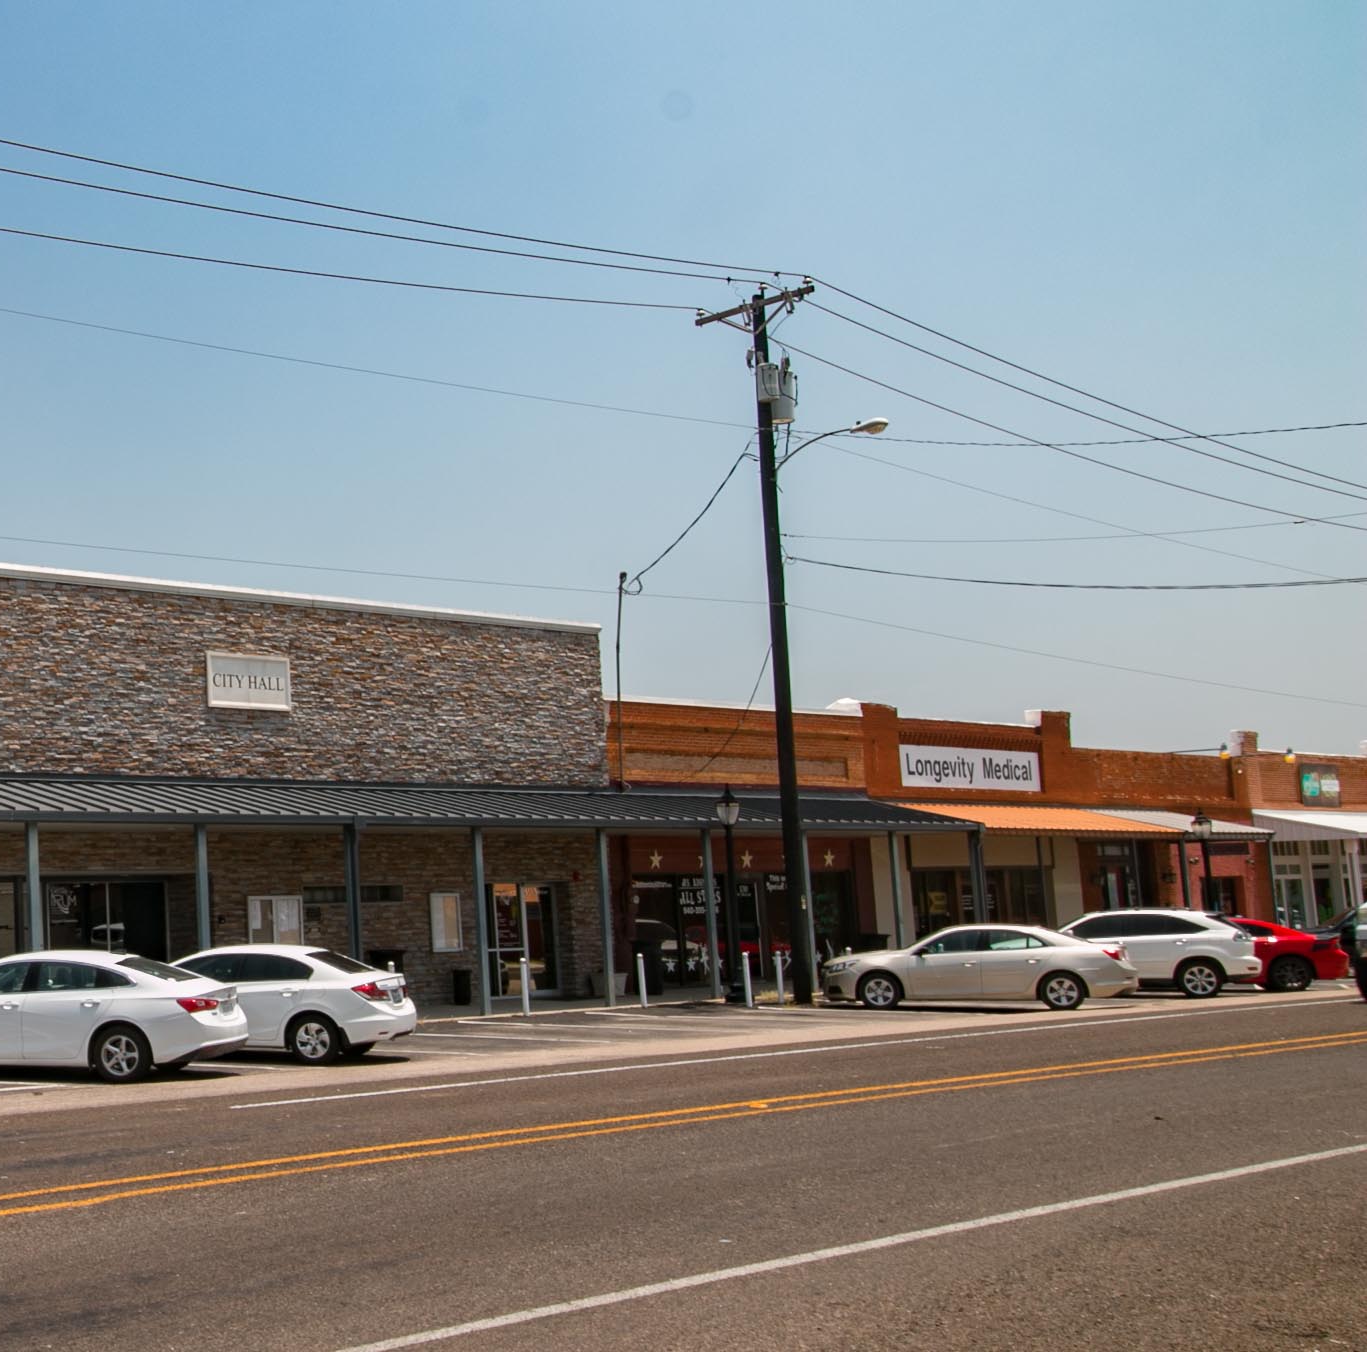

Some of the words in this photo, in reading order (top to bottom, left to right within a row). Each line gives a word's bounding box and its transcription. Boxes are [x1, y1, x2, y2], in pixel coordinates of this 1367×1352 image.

[213, 673, 244, 688] CITY
[248, 675, 284, 691] HALL
[905, 753, 975, 784] Longevity
[982, 757, 1033, 781] Medical
[696, 889, 721, 904] STS
